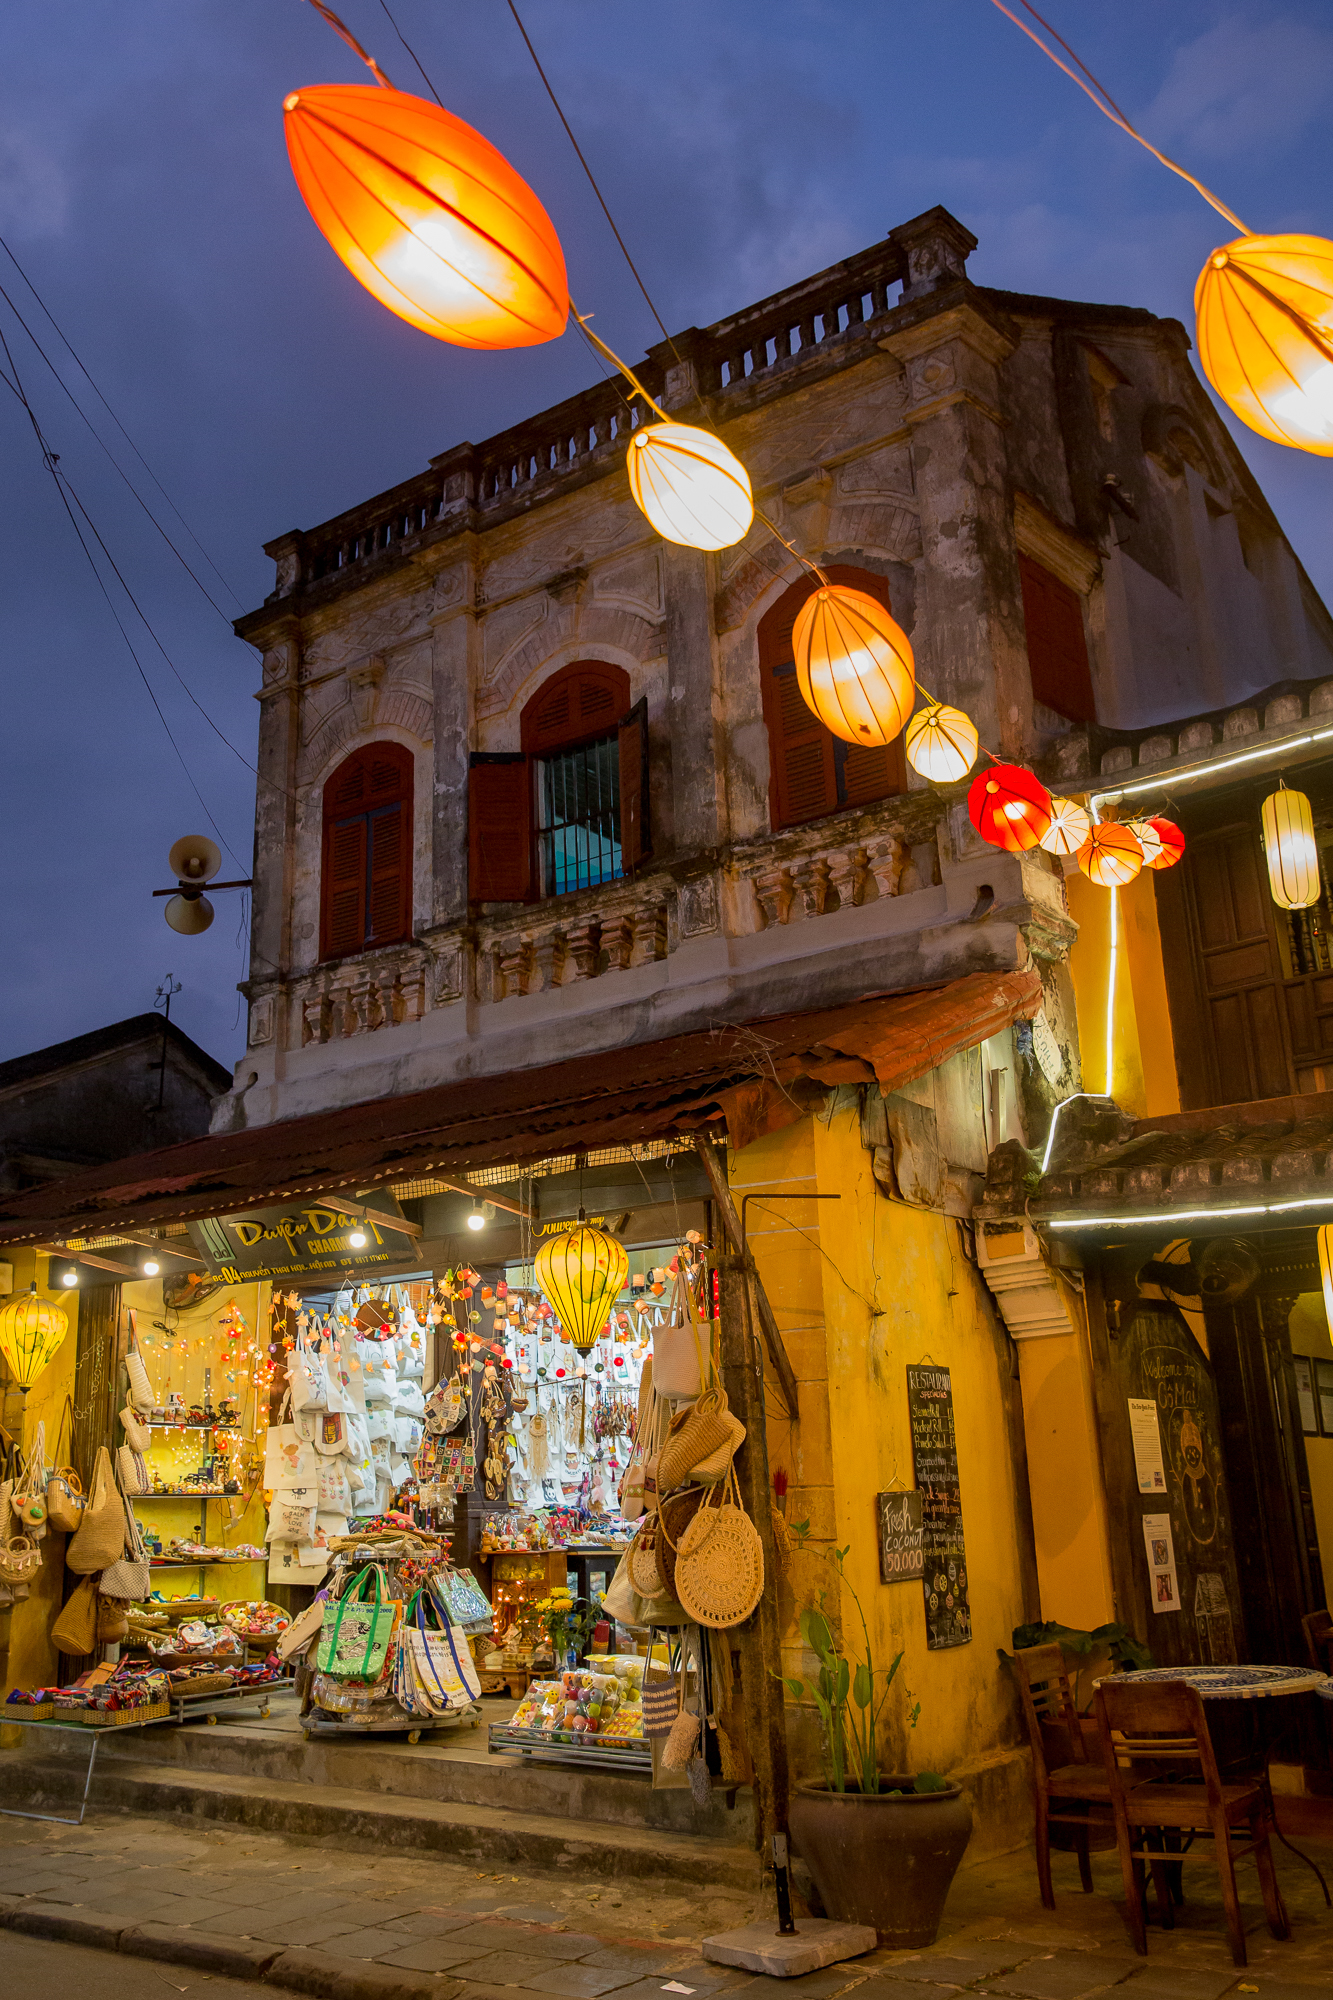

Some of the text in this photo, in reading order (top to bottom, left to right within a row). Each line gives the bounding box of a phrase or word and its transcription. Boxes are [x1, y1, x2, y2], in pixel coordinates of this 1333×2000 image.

[221, 1266, 243, 1284] 04
[1142, 1356, 1182, 1379] Welcome
[885, 1528, 925, 1553] COCONUT
[887, 1549, 924, 1573] 50.000
